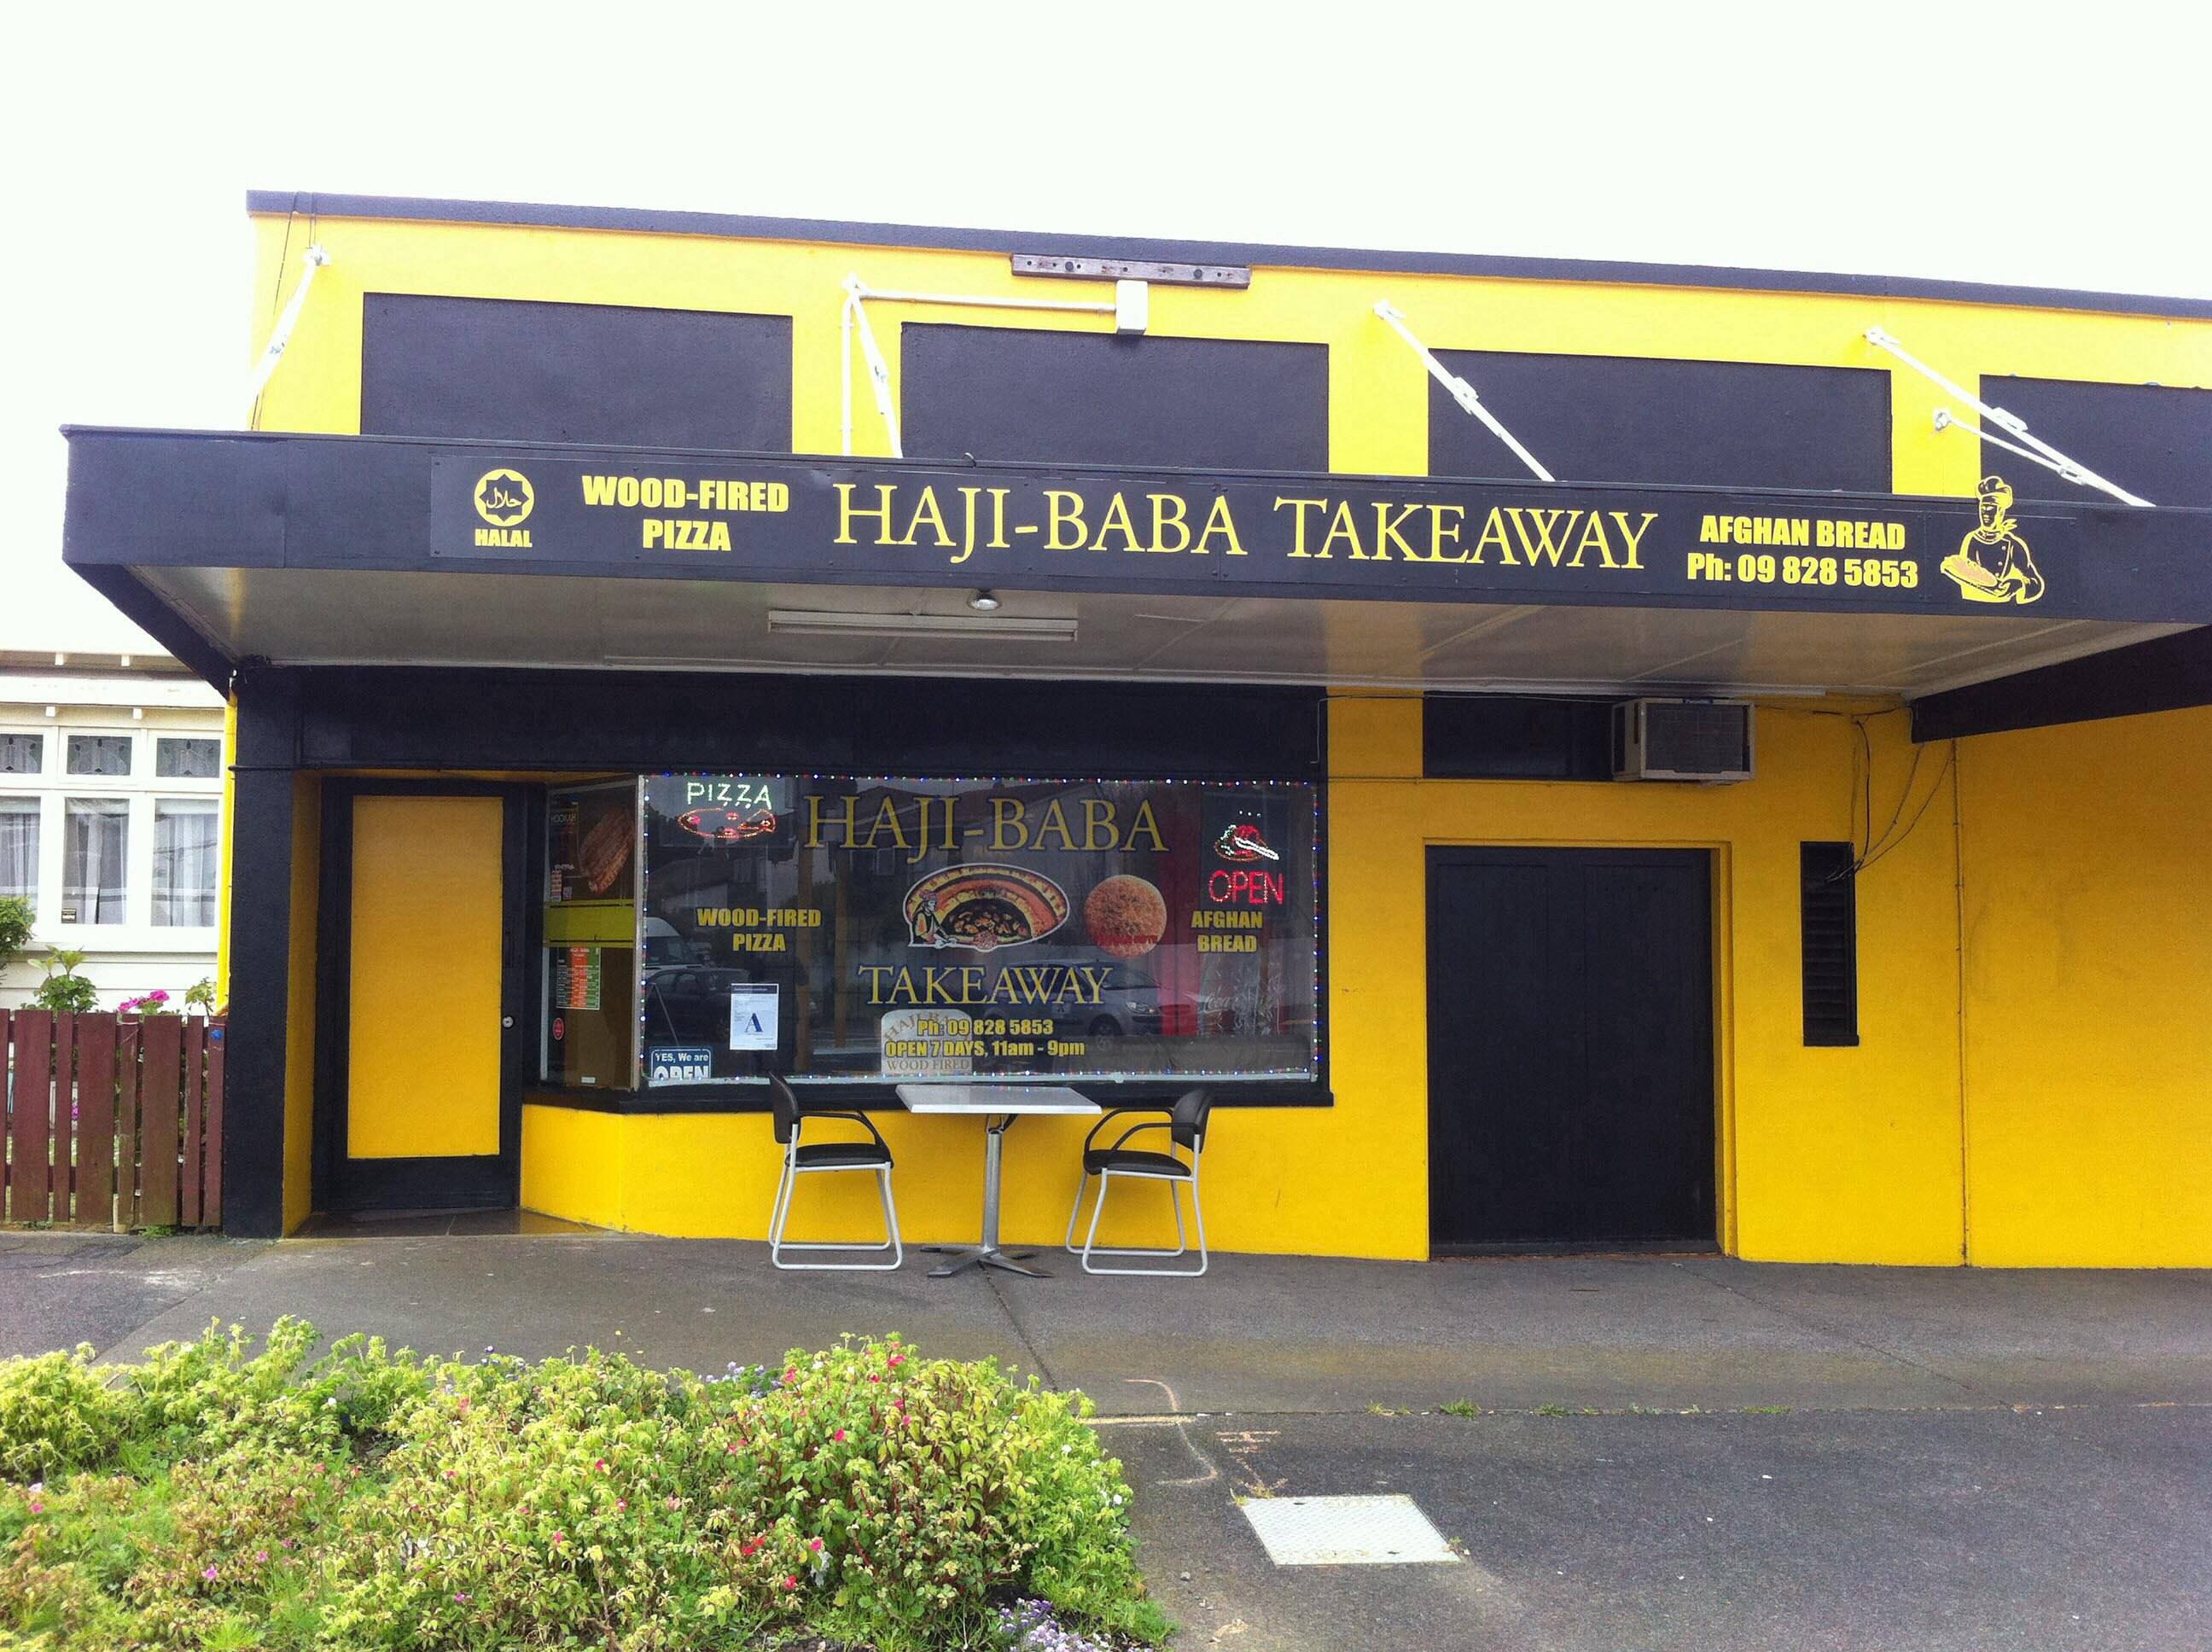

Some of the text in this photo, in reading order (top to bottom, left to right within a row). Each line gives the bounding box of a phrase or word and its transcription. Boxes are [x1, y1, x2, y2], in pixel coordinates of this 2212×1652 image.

[581, 474, 789, 512] WOOD-FIRED
[643, 519, 731, 551] PIZZA
[833, 484, 1658, 570] HAJI-BABA TAKEAWAY
[1700, 515, 1906, 550] AFGHAN BREAD
[474, 528, 533, 548] HALAL
[1687, 553, 1918, 588] Ph: 09 828 5853
[687, 782, 773, 810] PIZZA
[804, 794, 1170, 864] HAJI-BABA
[1208, 870, 1284, 905] OPEN
[696, 908, 822, 928] WOOD-FIRED
[1190, 910, 1264, 929] AFGHAN
[732, 933, 787, 952] PIZZA
[1197, 934, 1258, 952] BREAD
[858, 964, 1113, 1005] TAKEAWAY
[744, 1012, 765, 1033] A
[948, 1019, 970, 1036] 09
[974, 1019, 1006, 1035] 828
[1010, 1019, 1054, 1035] 5853
[655, 1052, 676, 1063] YES,
[678, 1052, 692, 1062] We
[885, 1040, 928, 1057] OPEN
[931, 1040, 941, 1057] 7
[943, 1040, 988, 1057] DAYS,
[992, 1040, 1034, 1056] 11am
[1047, 1039, 1086, 1057] 9pm
[653, 1065, 709, 1079] OPEN
[887, 1059, 928, 1071] WOOD
